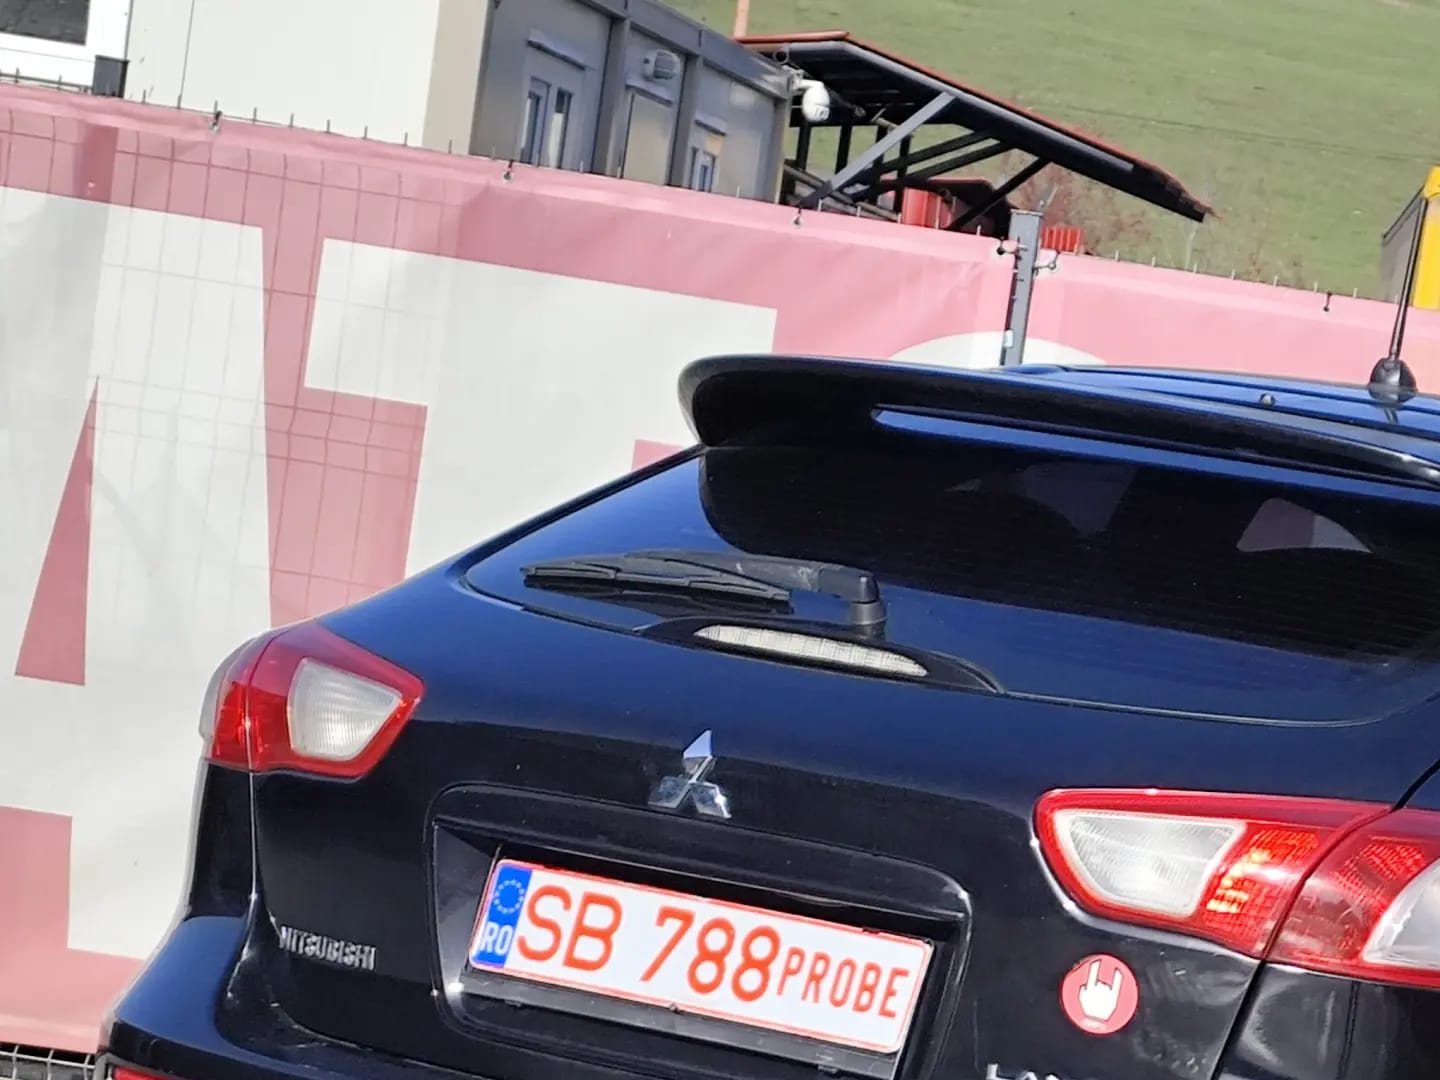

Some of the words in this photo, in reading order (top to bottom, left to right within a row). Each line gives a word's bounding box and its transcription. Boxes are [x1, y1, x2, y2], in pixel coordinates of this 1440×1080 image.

[279, 925, 377, 970] MITSUBISHI
[479, 921, 514, 956] RO
[517, 885, 623, 971] SB
[639, 905, 782, 1002] 788
[776, 946, 910, 1020] PROBE
